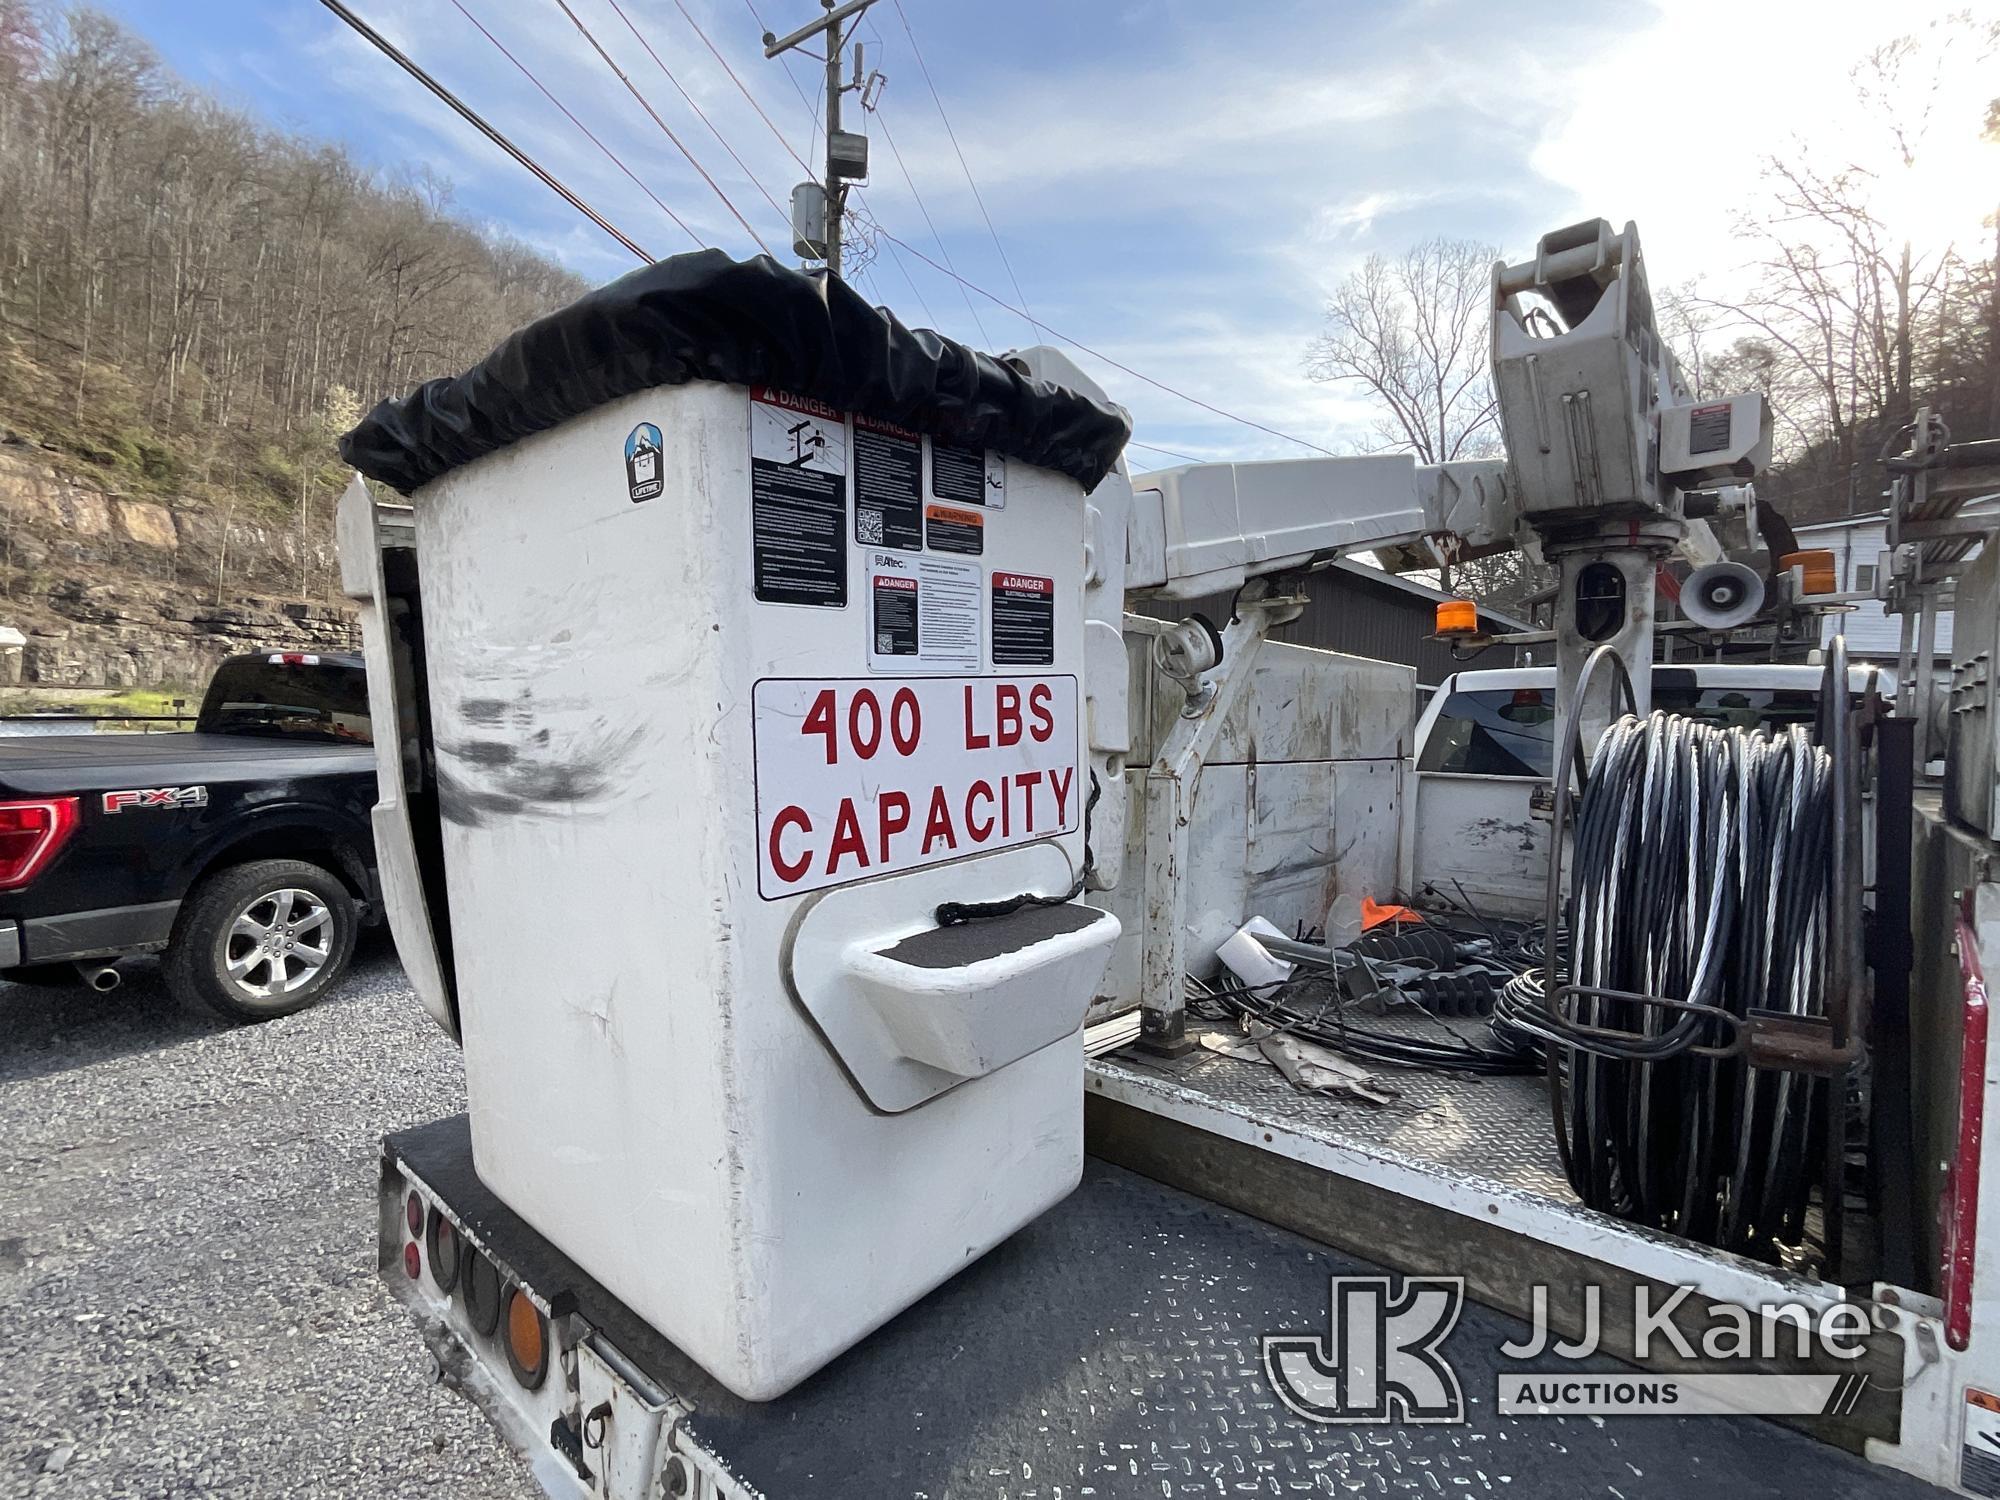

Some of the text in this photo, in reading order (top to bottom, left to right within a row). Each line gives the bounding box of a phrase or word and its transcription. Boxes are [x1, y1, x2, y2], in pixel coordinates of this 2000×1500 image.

[883, 556, 904, 569] Altec
[883, 578, 915, 589] DANGER
[1010, 577, 1044, 590] DANGER
[801, 683, 1054, 764] 400 LBS
[102, 786, 208, 814] FX4
[769, 767, 1074, 883] CAPACITY
